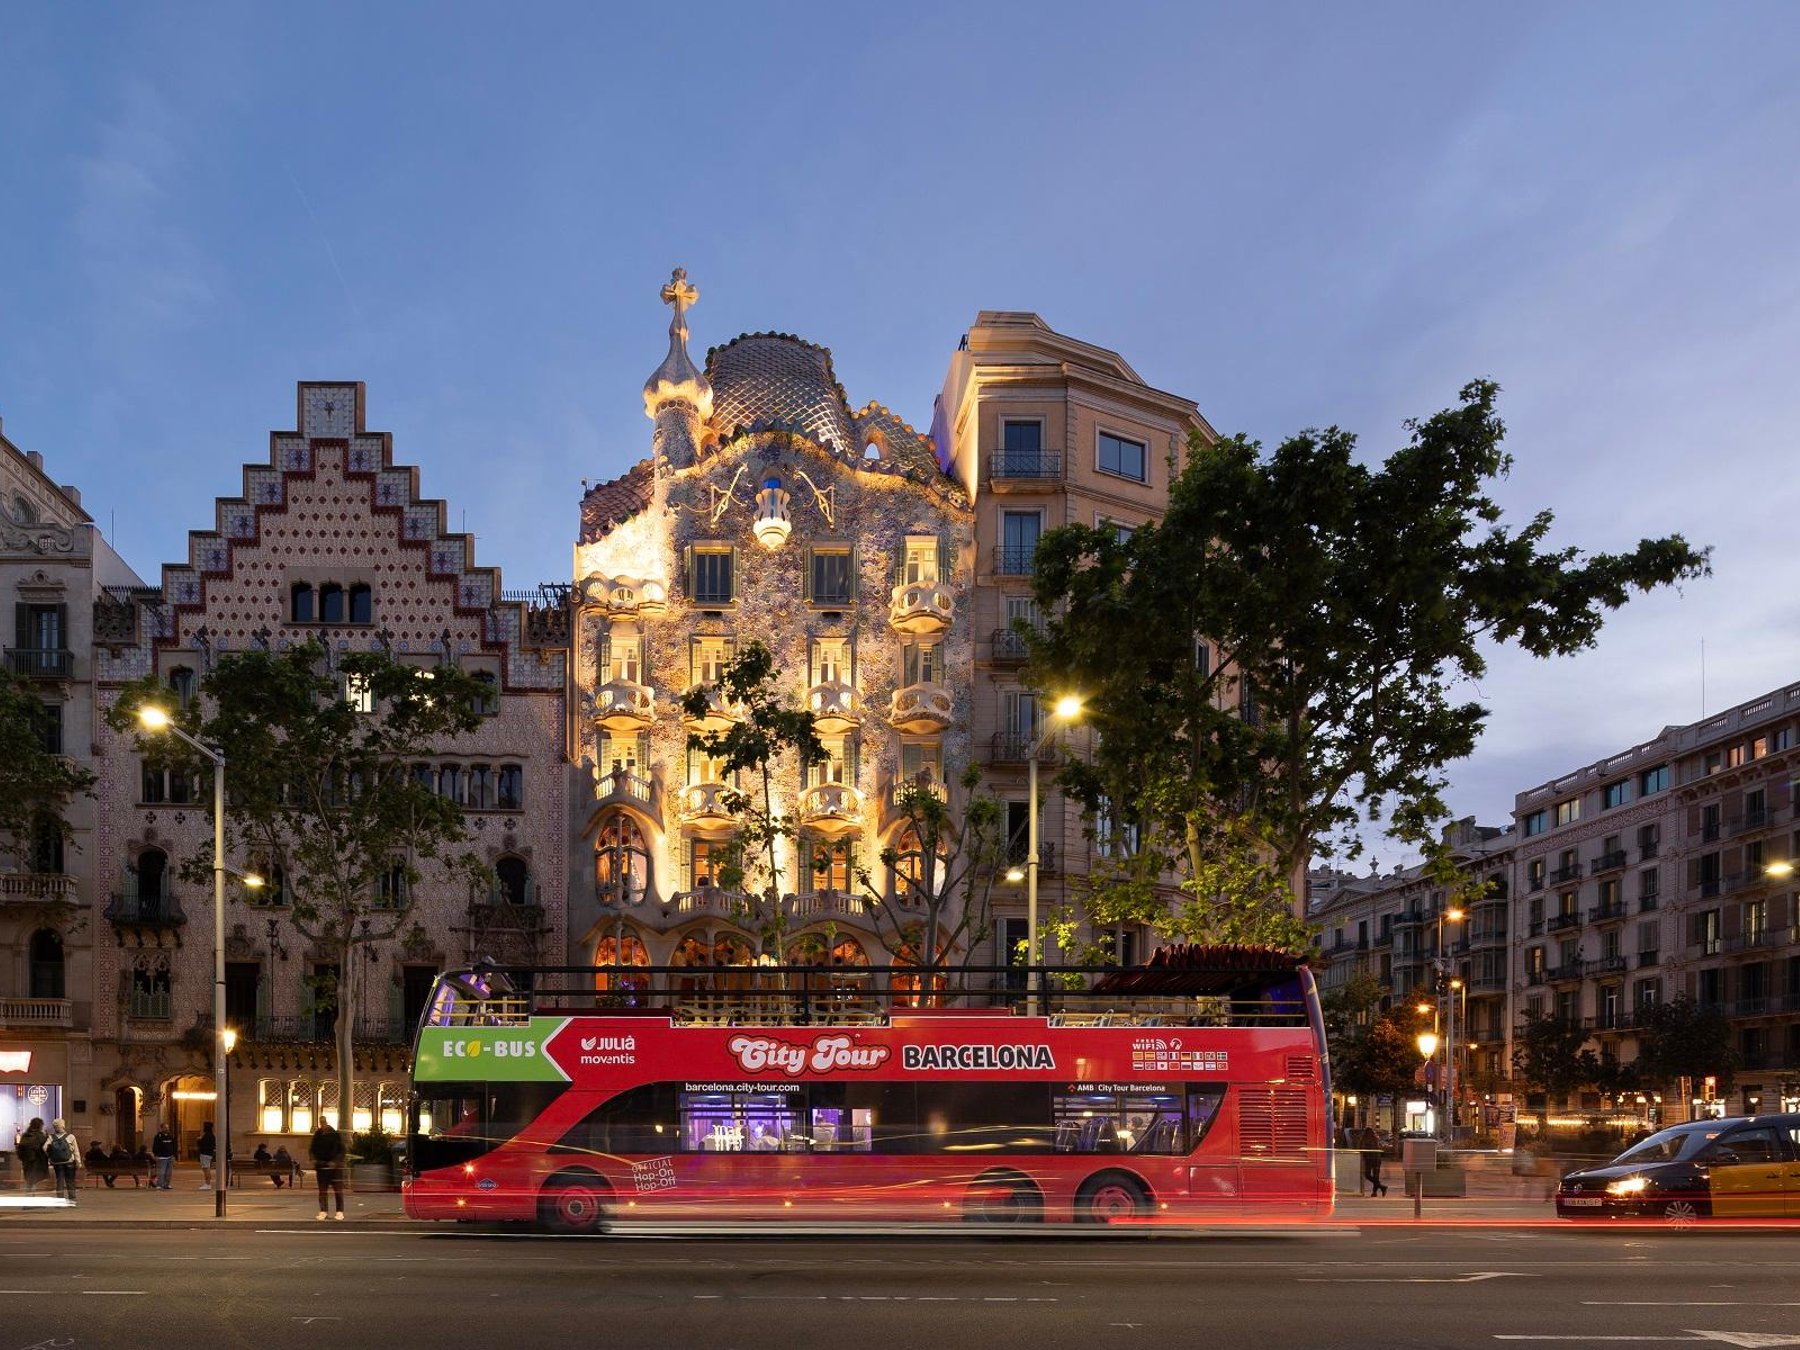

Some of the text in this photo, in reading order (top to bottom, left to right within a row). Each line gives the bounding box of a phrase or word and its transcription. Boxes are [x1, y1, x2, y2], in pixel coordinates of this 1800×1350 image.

[731, 1037, 886, 1073] City Tour
[903, 1045, 1055, 1069] BARCELONA
[685, 1082, 800, 1093] barcelona.city-tour.com
[1077, 1083, 1166, 1093] AMB City Tour Barcelona
[632, 1158, 673, 1173] OFFICIAL
[633, 1168, 674, 1182] Hop-On
[635, 1176, 676, 1191] Hop-Off
